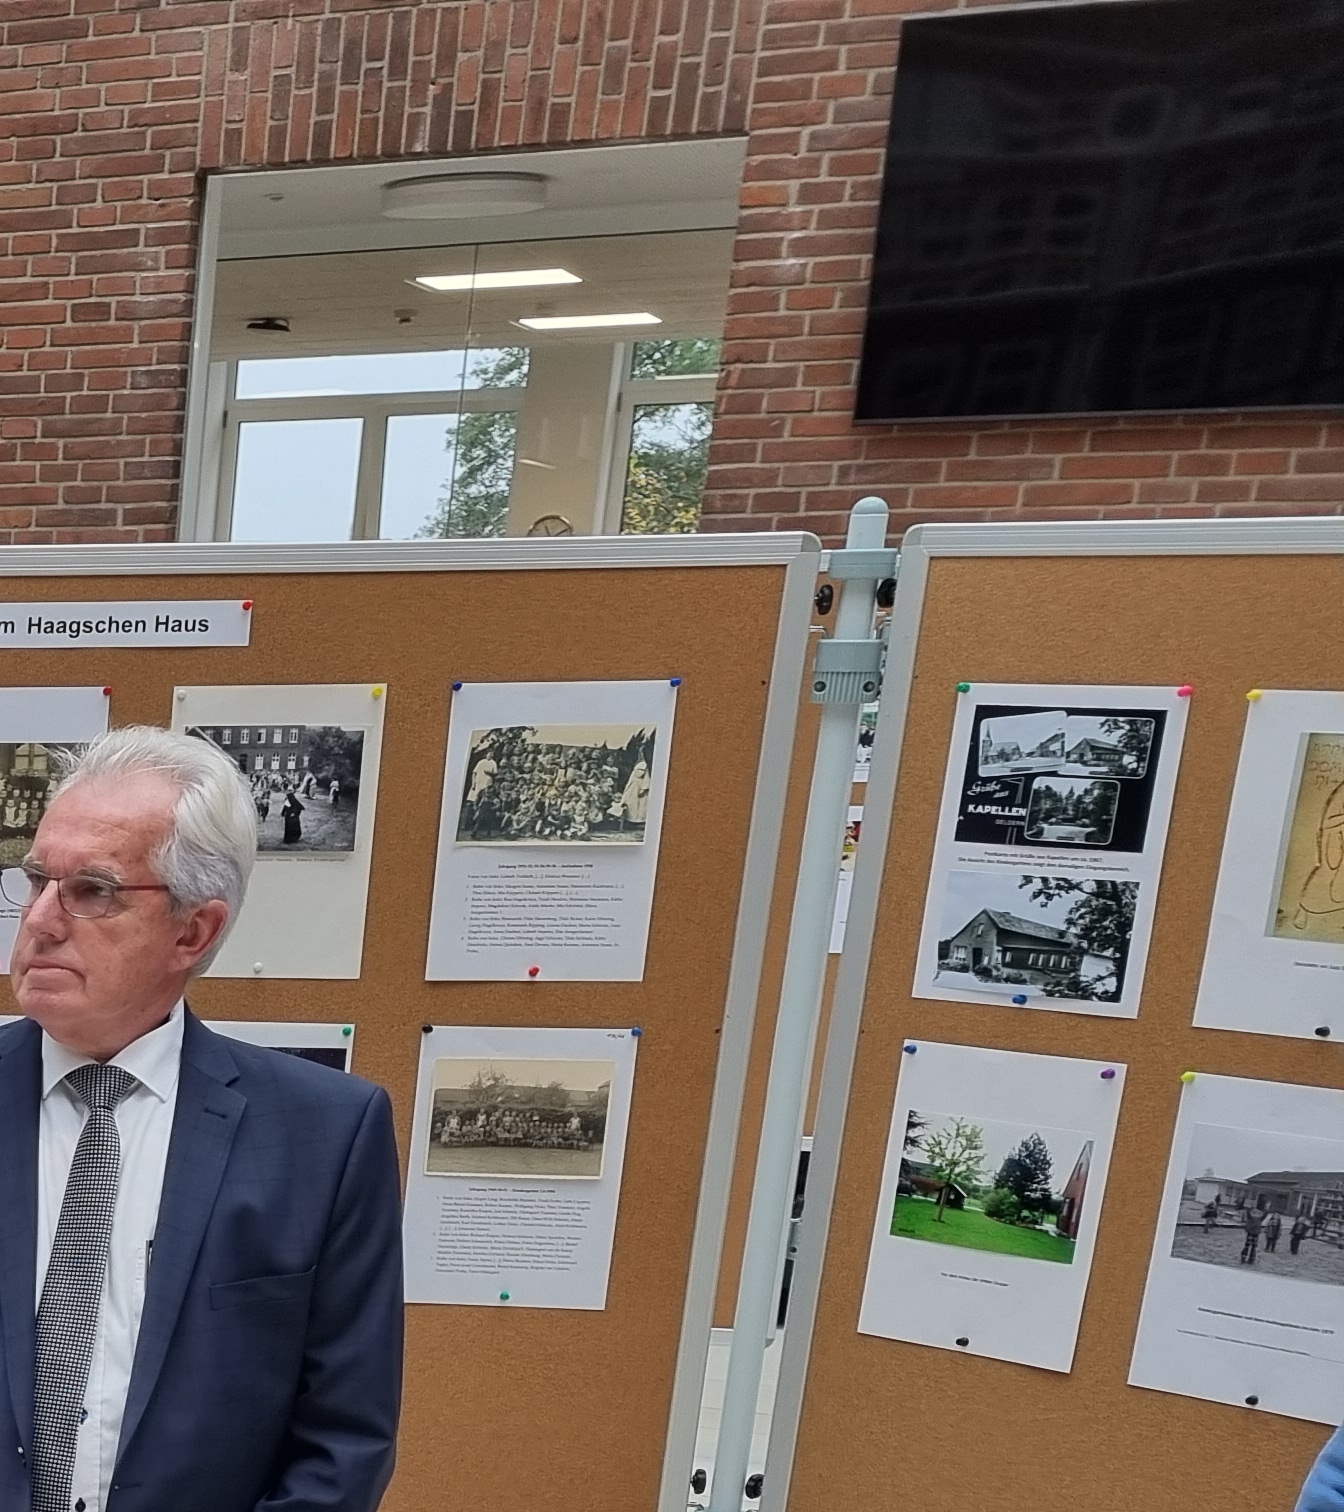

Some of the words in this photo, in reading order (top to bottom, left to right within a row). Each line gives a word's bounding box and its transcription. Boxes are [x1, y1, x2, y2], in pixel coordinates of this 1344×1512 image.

[27, 615, 147, 640] Haagschen
[154, 614, 210, 633] Haus
[967, 803, 1028, 816] KAPELLEN
